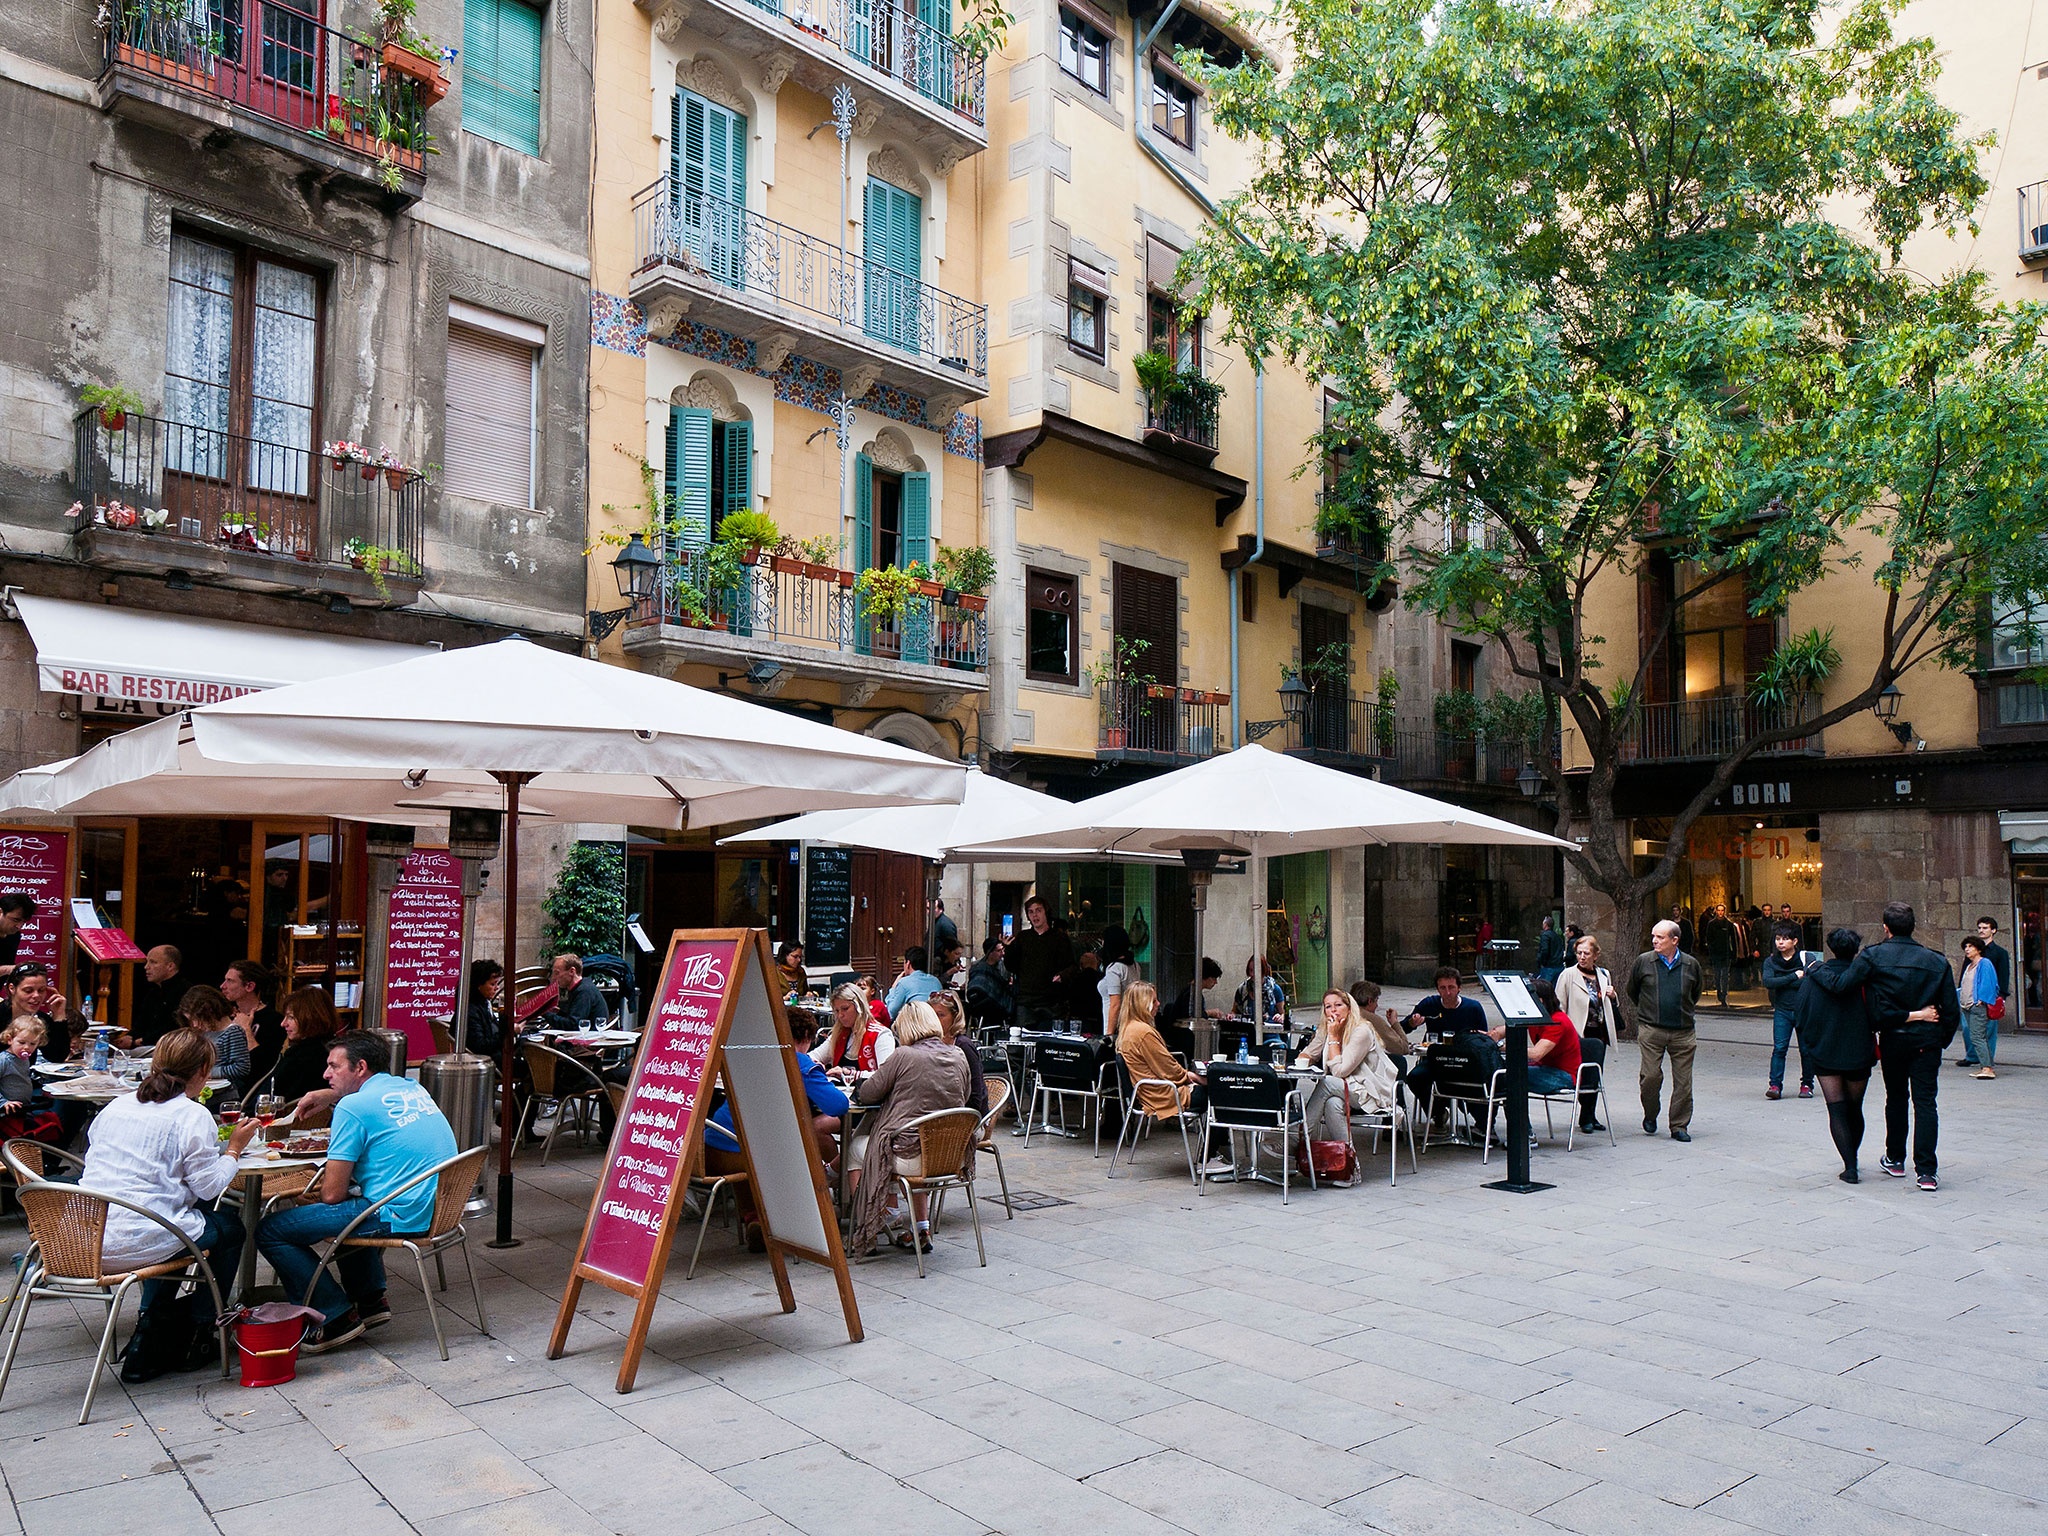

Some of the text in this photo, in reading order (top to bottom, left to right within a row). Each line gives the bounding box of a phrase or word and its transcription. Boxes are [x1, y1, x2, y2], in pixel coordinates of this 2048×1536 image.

[62, 670, 261, 703] BAR RESTAURAN
[1733, 782, 1791, 805] BORN
[0, 836, 48, 850] PAS
